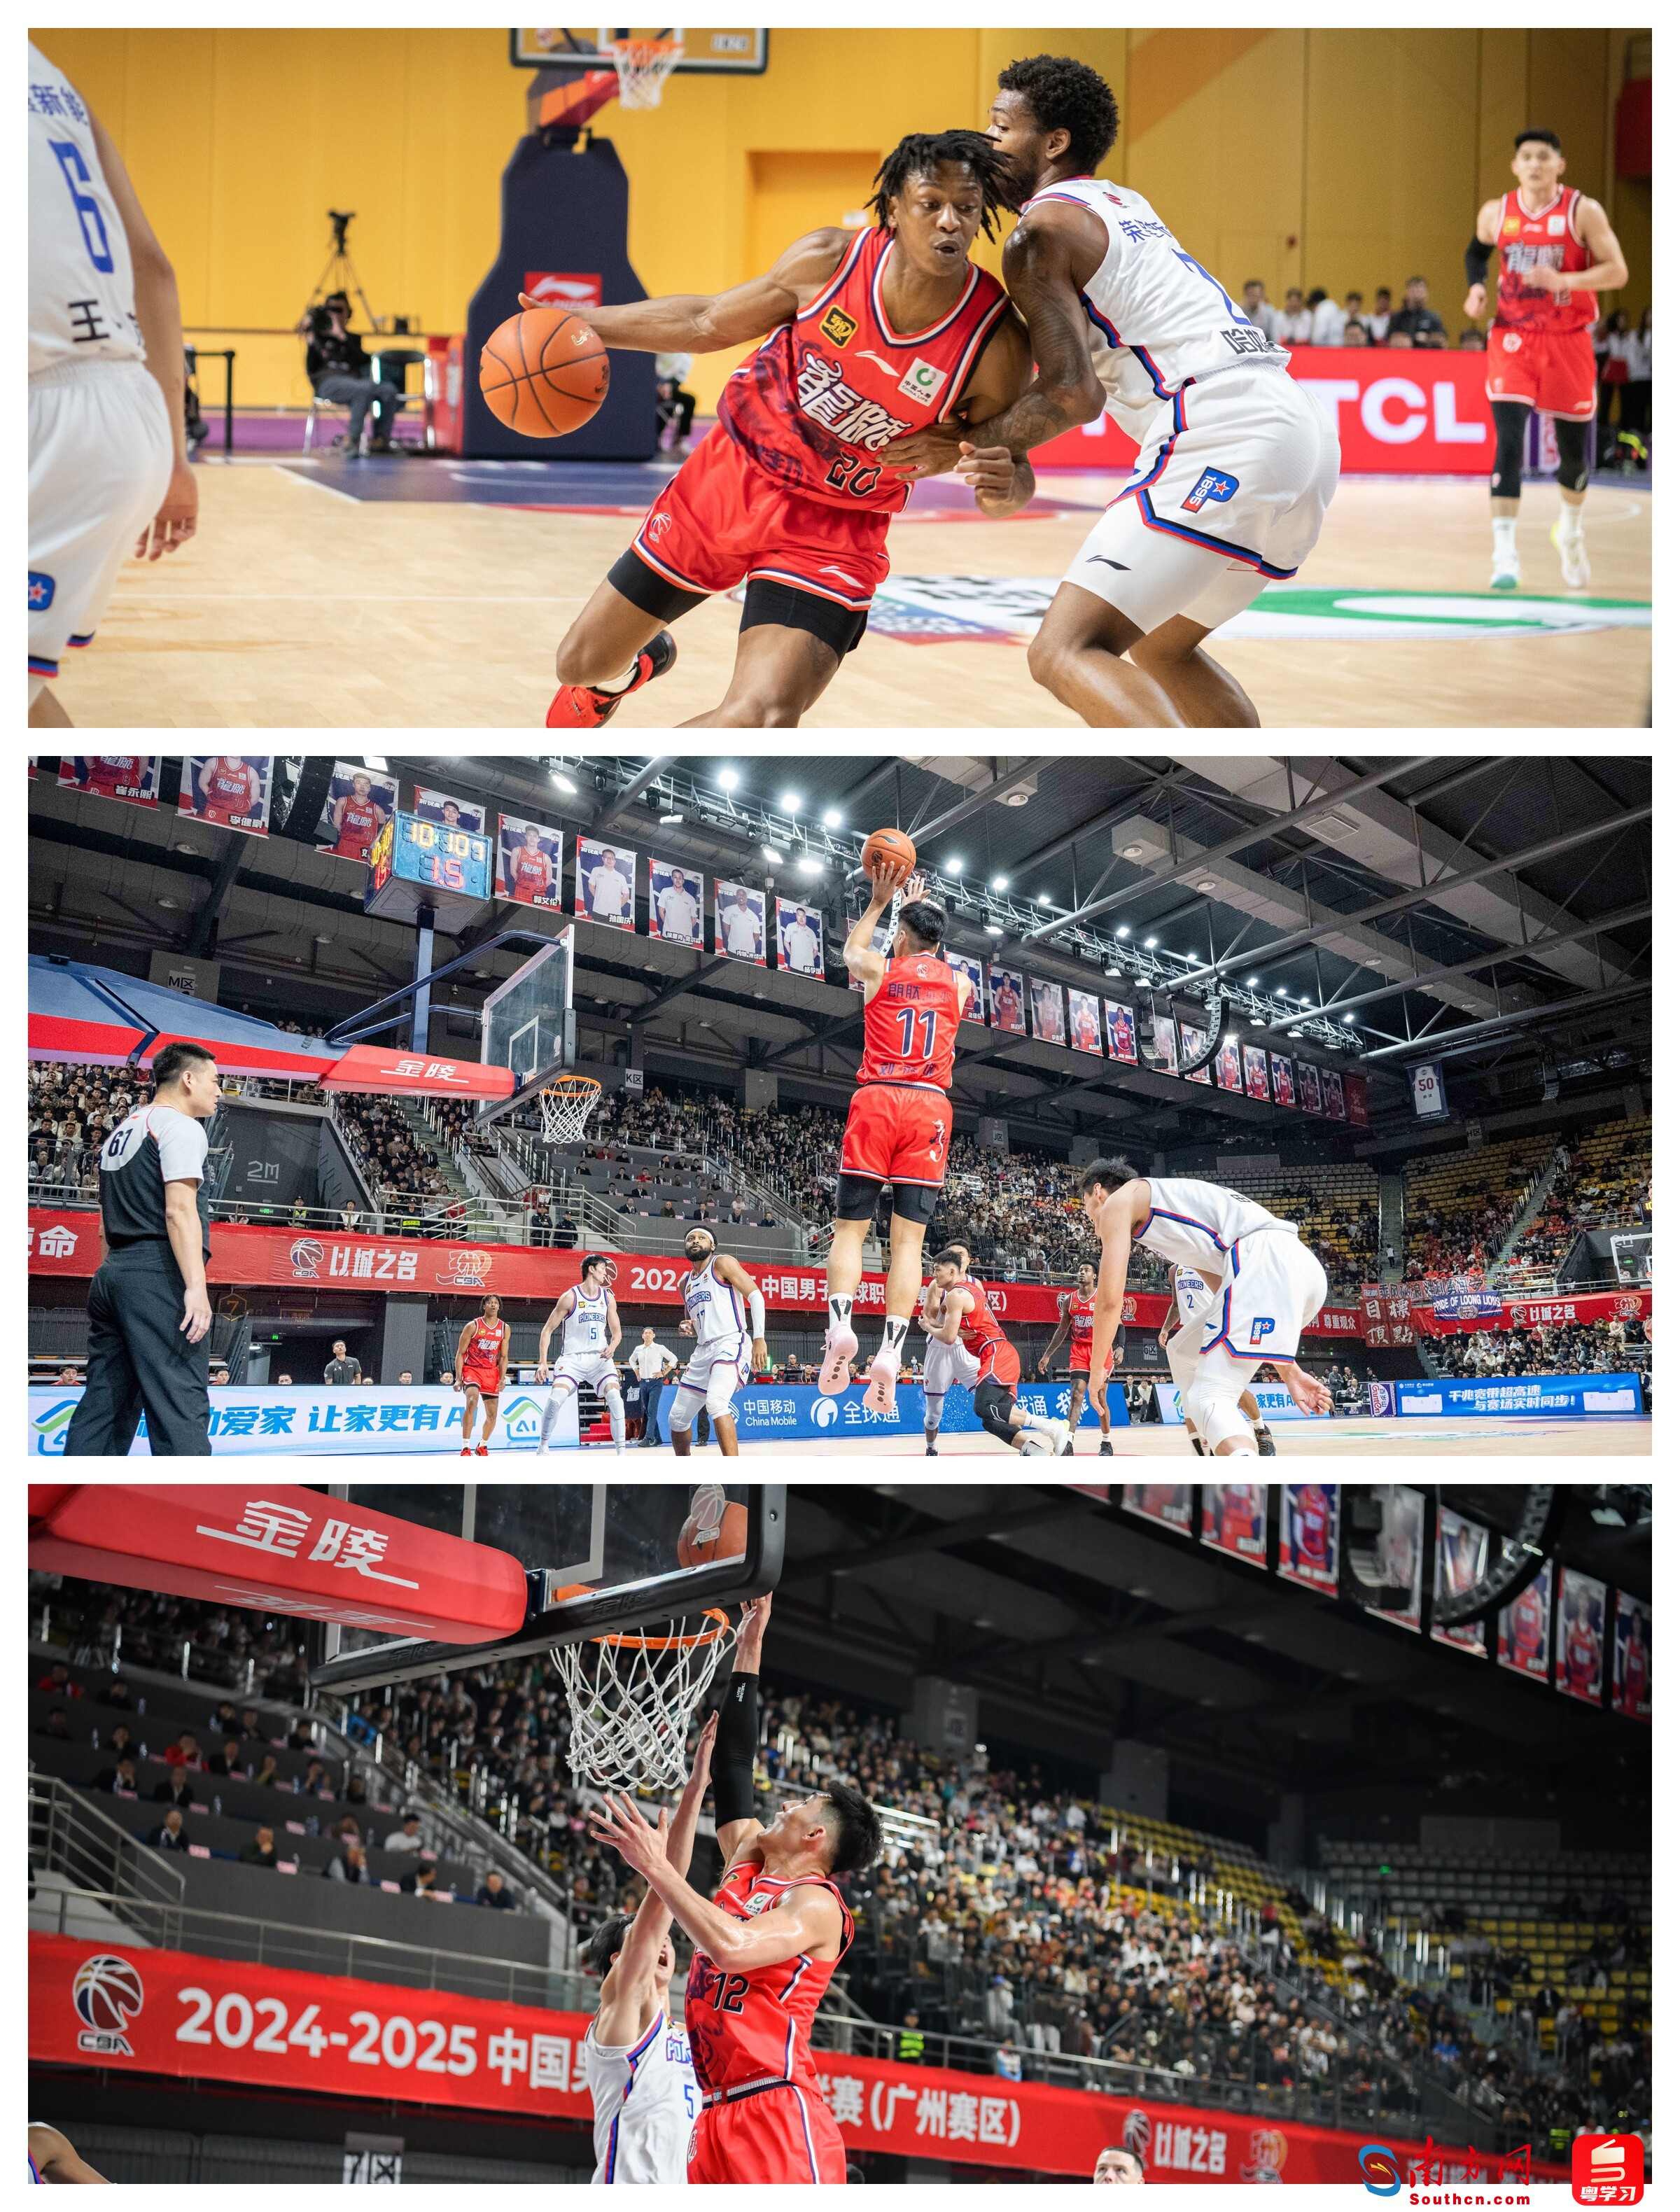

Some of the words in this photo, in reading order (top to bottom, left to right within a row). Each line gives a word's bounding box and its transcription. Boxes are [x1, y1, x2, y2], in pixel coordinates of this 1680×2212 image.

[47, 139, 113, 274] 6
[902, 385, 916, 396] CHINA
[917, 395, 929, 403] LIFE
[904, 379, 932, 400] 中国人寿
[1296, 377, 1487, 445] TCL
[825, 450, 883, 498] 20
[1189, 475, 1215, 508] 1895
[533, 895, 559, 906] 郭艾伦
[608, 913, 632, 925] 孙国庆
[167, 976, 195, 990] M区
[896, 1007, 937, 1060] 11
[625, 1072, 643, 1086] K区
[1418, 1077, 1434, 1092] 50
[329, 1245, 419, 1281] 以城之名
[292, 1268, 320, 1279] CBA
[453, 1275, 485, 1287] CBA
[226, 1301, 239, 1315] 7
[1186, 1294, 1194, 1309] 2
[1365, 1299, 1411, 1320] 目標
[1432, 1298, 1449, 1312] PRIDE
[1450, 1297, 1459, 1306] OF
[1460, 1295, 1481, 1306] LOONG
[1483, 1296, 1501, 1308] LIONS
[578, 1311, 606, 1324] PIONEERS
[1324, 1314, 1357, 1330] 尊重观众
[1530, 1304, 1576, 1322] 以城之名
[590, 1327, 596, 1340] 5
[1379, 1388, 1387, 1408] 百岁山
[1448, 1385, 1541, 1401] 千兆宽带超高速
[743, 1399, 797, 1415] 中国移动
[844, 1399, 902, 1425] 全球通
[745, 1416, 770, 1427] China
[771, 1415, 797, 1427] Mobile
[196, 1499, 419, 1590] 金陵
[713, 1971, 750, 2015] 12
[175, 1986, 478, 2077] 2024-2025
[77, 2029, 135, 2057] CBA
[684, 2083, 694, 2120] 5
[1153, 2121, 1227, 2175] 以城之名
